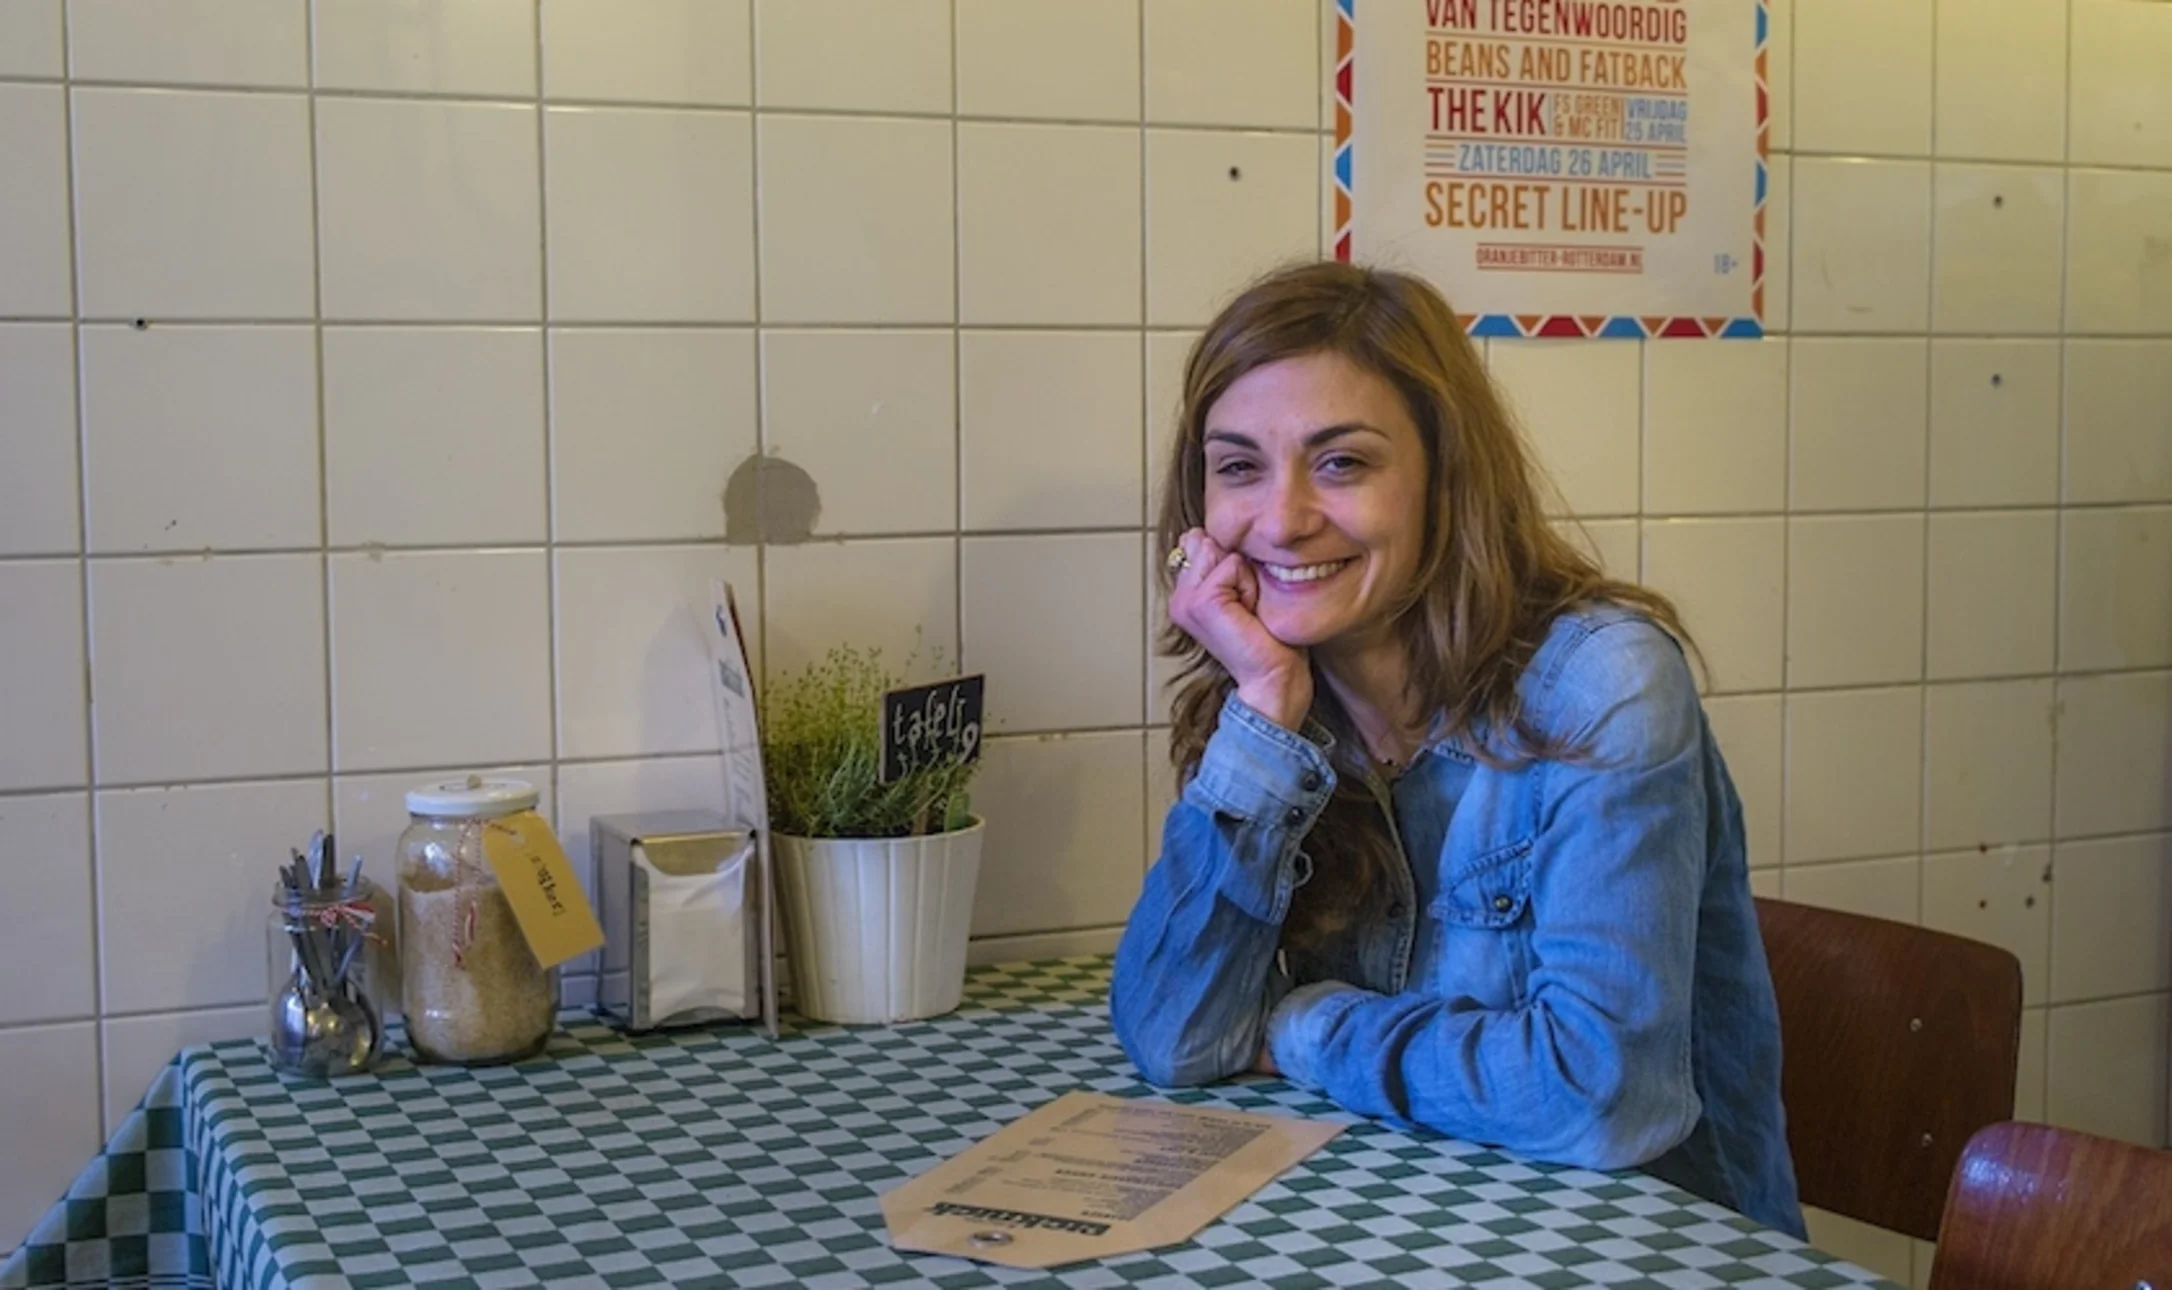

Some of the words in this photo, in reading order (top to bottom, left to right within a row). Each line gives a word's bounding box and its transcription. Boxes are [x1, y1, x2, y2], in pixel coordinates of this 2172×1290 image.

[1425, 0, 1477, 29] VAN
[1488, 0, 1687, 43] TEGENWOORDIG
[1426, 40, 1510, 78] BEANS
[1519, 46, 1571, 81] AND
[1580, 50, 1687, 89] FATBACK
[1426, 87, 1487, 133] THE
[1494, 91, 1546, 136] KIK
[1574, 94, 1621, 117] GREEN
[1627, 98, 1688, 121] VRIJDAG
[1568, 116, 1592, 139] MC
[1596, 118, 1619, 140] FIT
[1648, 121, 1688, 144] APRIL
[1459, 144, 1562, 175] ZATERDAG
[1568, 149, 1592, 176] 26
[1597, 151, 1652, 178] APRIL
[1425, 181, 1550, 229] SECRET
[1561, 187, 1687, 234] LINE-UP
